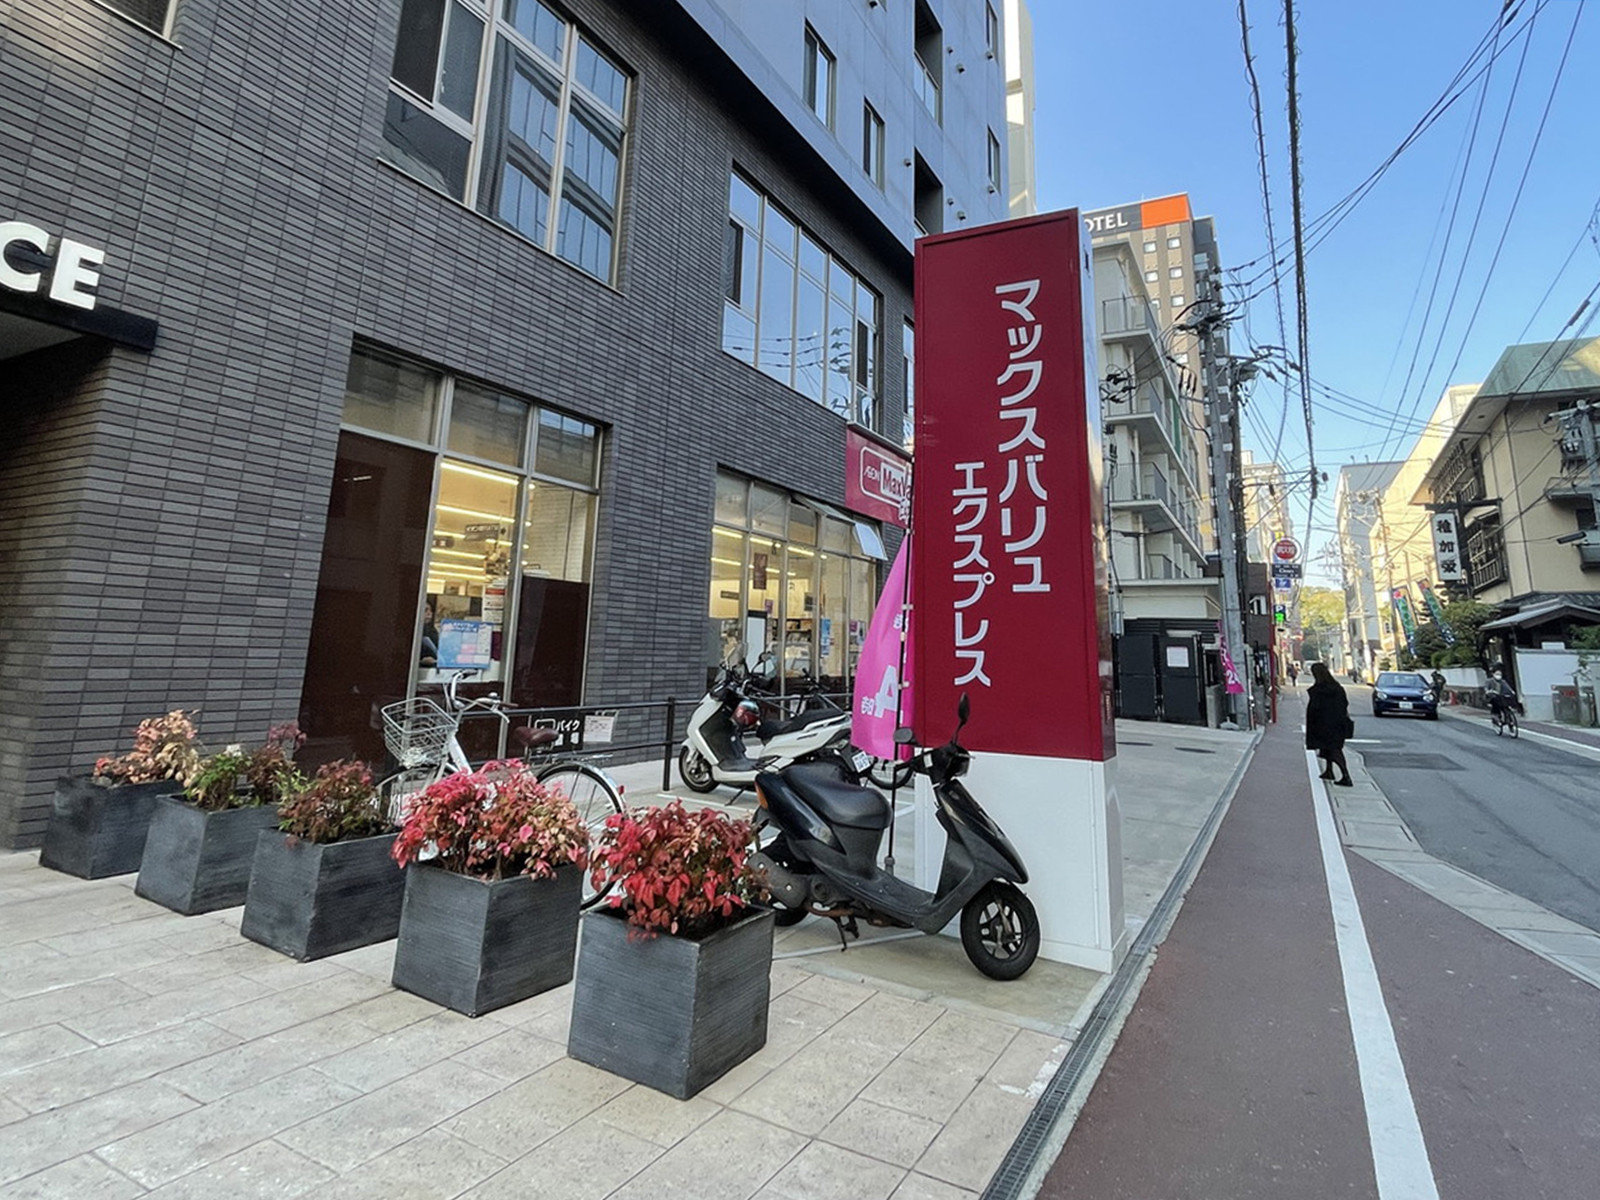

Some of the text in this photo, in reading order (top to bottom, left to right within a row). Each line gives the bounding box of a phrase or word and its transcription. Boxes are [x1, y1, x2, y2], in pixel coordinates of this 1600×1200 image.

[0, 221, 105, 311] CE
[995, 278, 1051, 592] マックスバリュ
[952, 461, 996, 687] エクスプレス
